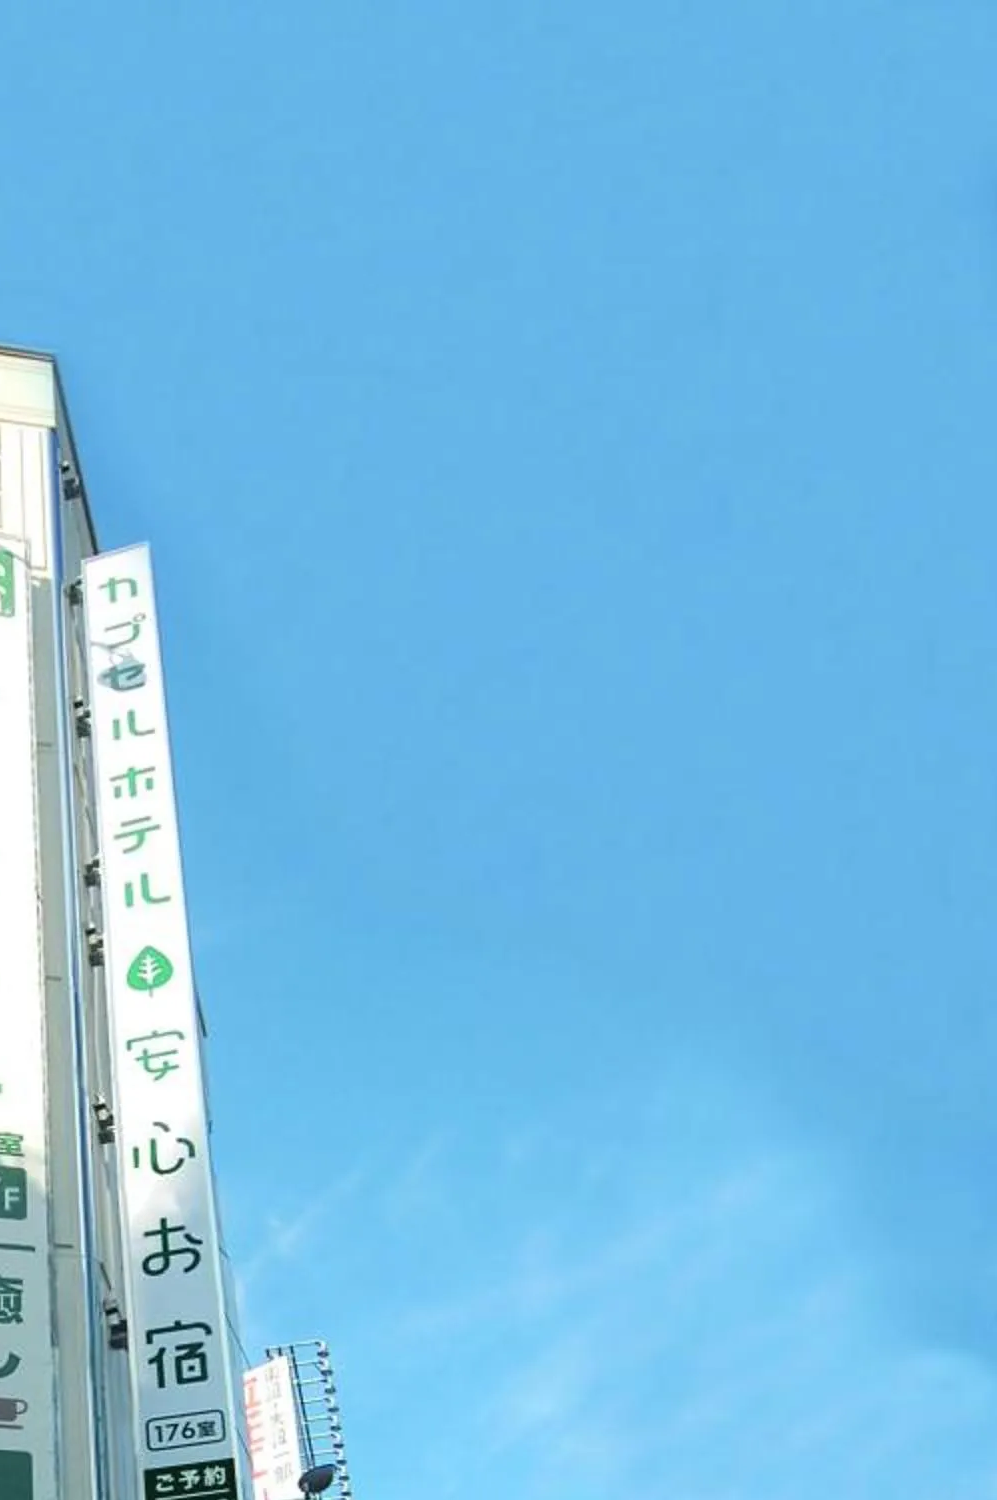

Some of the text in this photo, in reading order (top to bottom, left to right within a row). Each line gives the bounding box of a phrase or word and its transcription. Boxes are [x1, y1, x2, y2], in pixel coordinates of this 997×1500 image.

[97, 577, 214, 1390] カプセルホテル 安心お宿
[155, 1419, 221, 1445] 176室
[154, 1465, 227, 1493] ご予約
